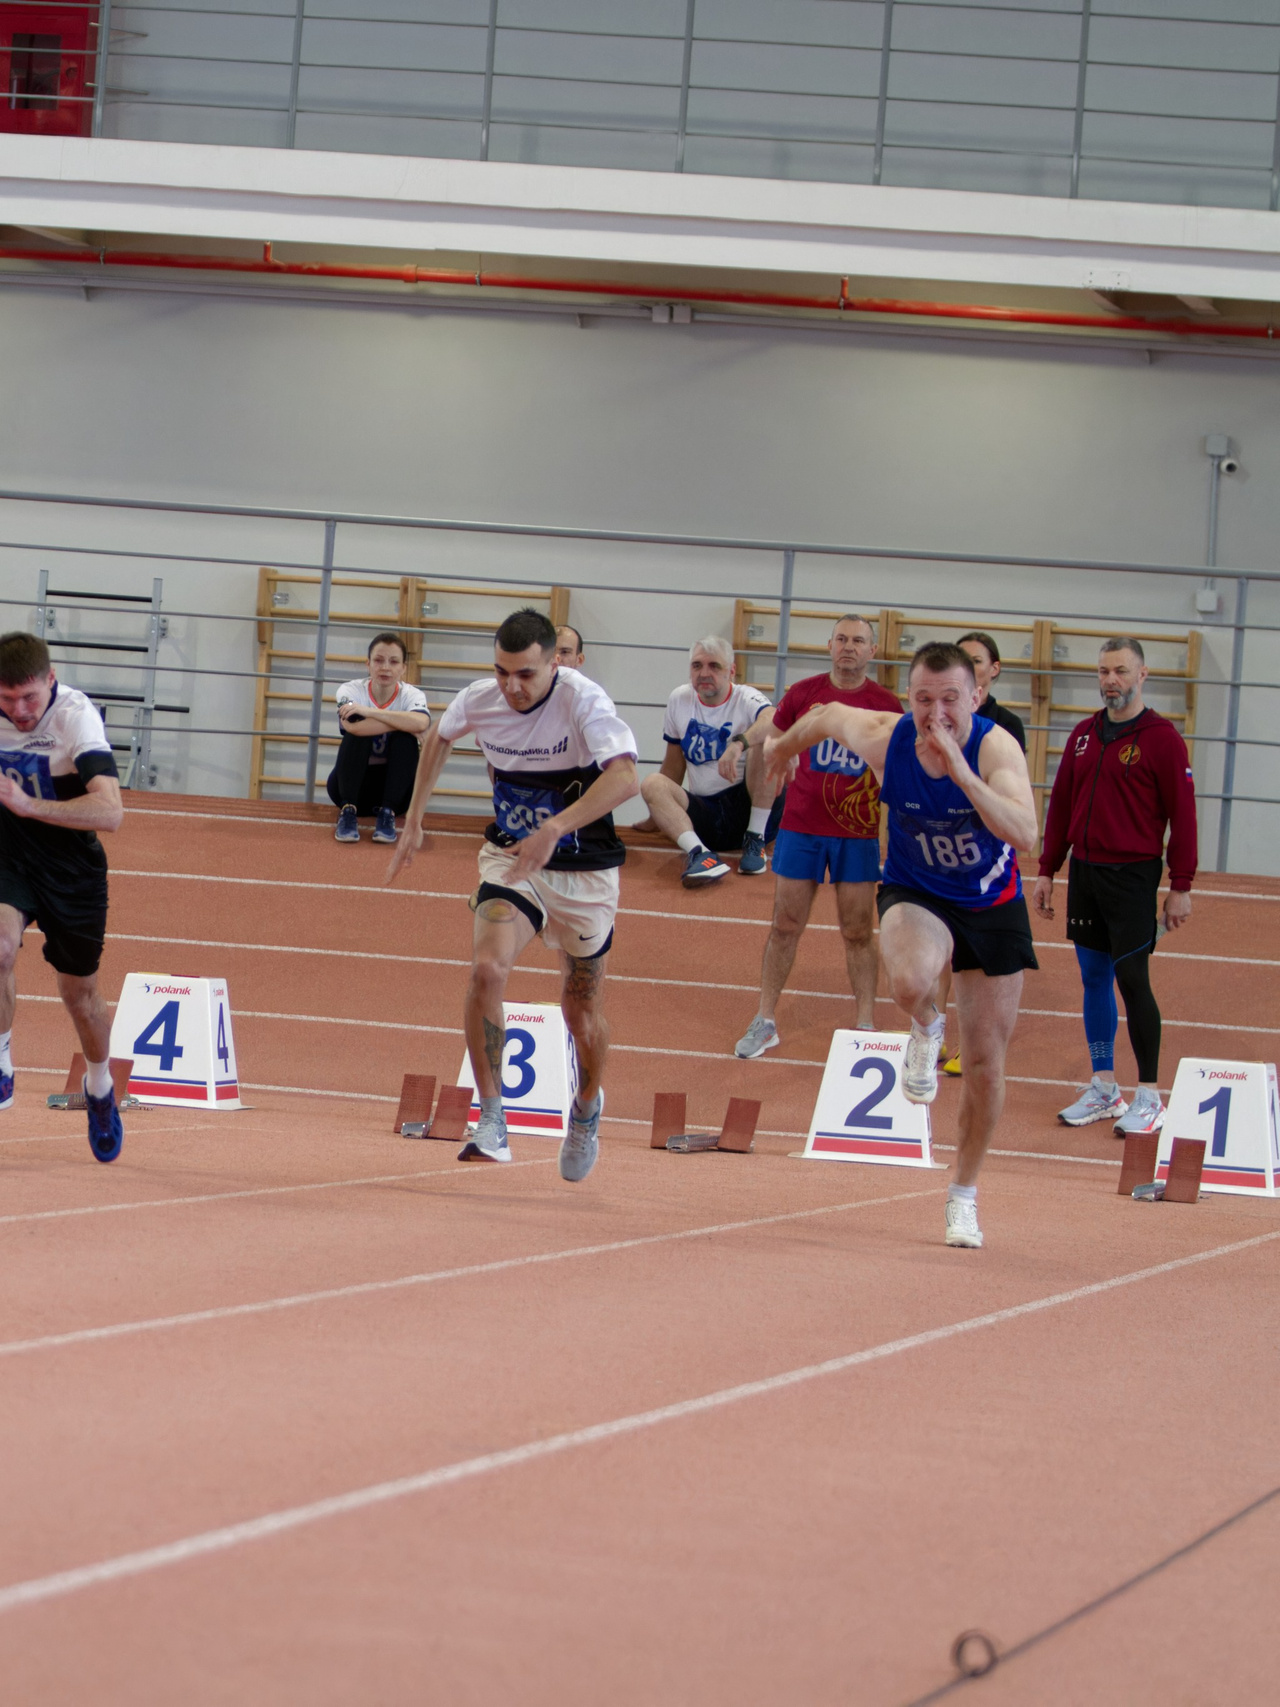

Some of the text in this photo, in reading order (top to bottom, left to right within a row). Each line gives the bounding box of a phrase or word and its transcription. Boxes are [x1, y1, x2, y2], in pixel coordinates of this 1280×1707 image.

[687, 734, 718, 762] 131
[914, 832, 982, 868] 185
[153, 985, 192, 995] polanik
[133, 1000, 183, 1071] 4
[506, 1013, 546, 1023] polanik
[217, 1002, 229, 1073] 4
[863, 1042, 903, 1052] polanik
[501, 1028, 536, 1098] 3
[1208, 1070, 1248, 1081] polanik
[844, 1056, 896, 1130] 2
[1198, 1086, 1232, 1157] 1
